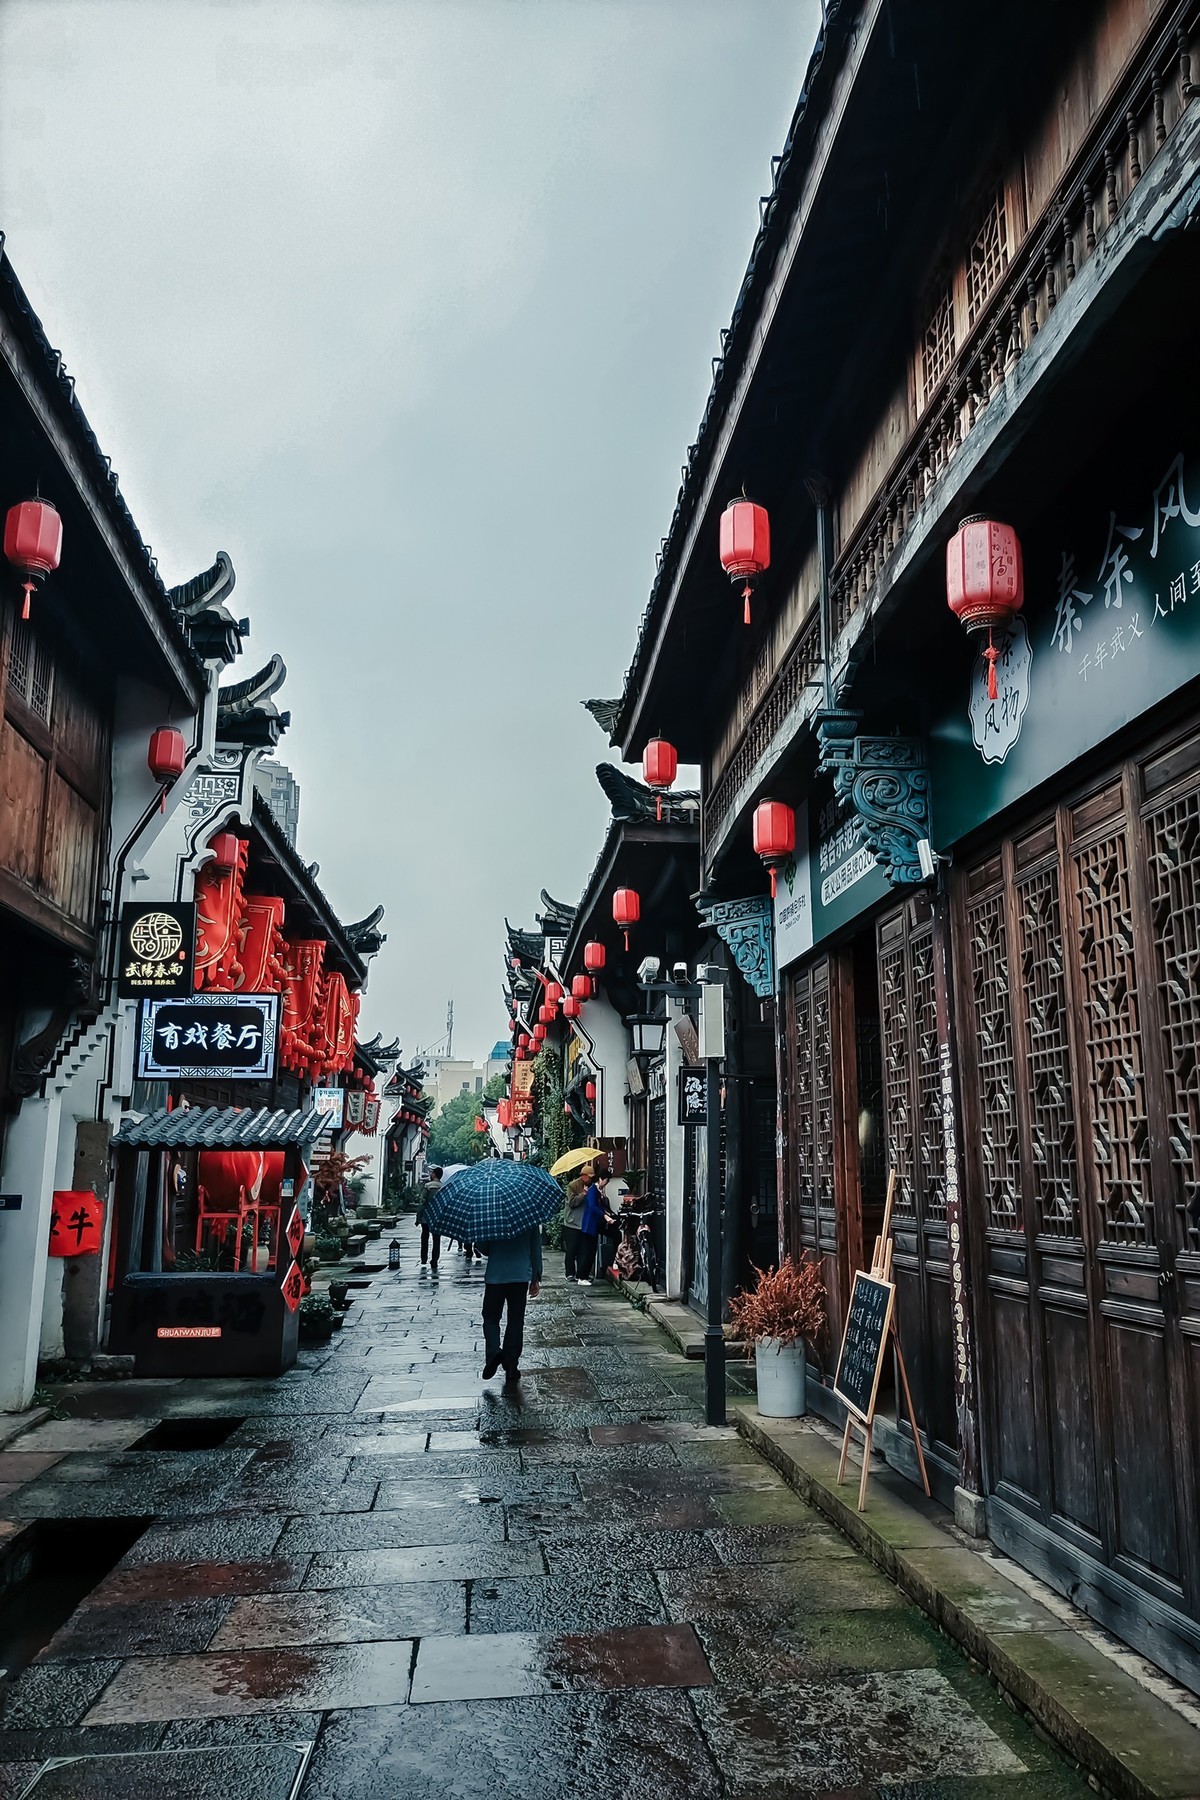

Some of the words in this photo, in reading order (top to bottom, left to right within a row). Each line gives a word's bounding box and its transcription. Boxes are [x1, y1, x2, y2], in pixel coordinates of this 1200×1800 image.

[1078, 611, 1144, 682] 千年武义
[156, 1021, 262, 1050] 有戏餐厅
